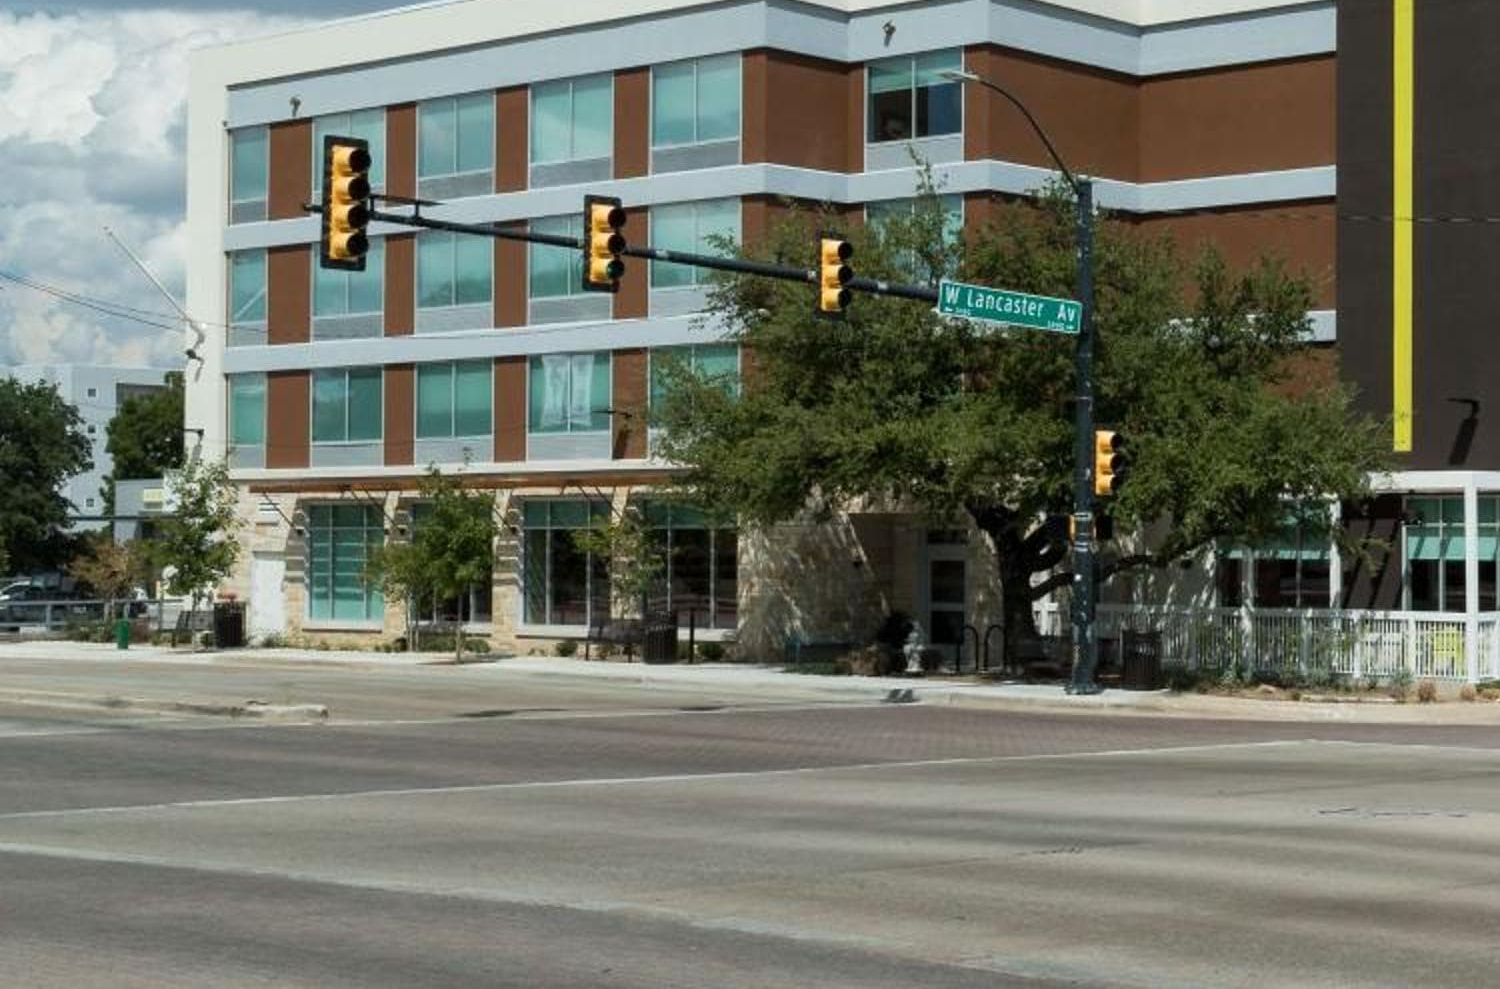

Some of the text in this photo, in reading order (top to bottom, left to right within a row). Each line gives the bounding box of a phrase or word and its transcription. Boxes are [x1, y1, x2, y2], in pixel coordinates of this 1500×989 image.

[945, 285, 960, 305] W
[967, 289, 1044, 318] Lancaster
[1057, 303, 1075, 323] Av
